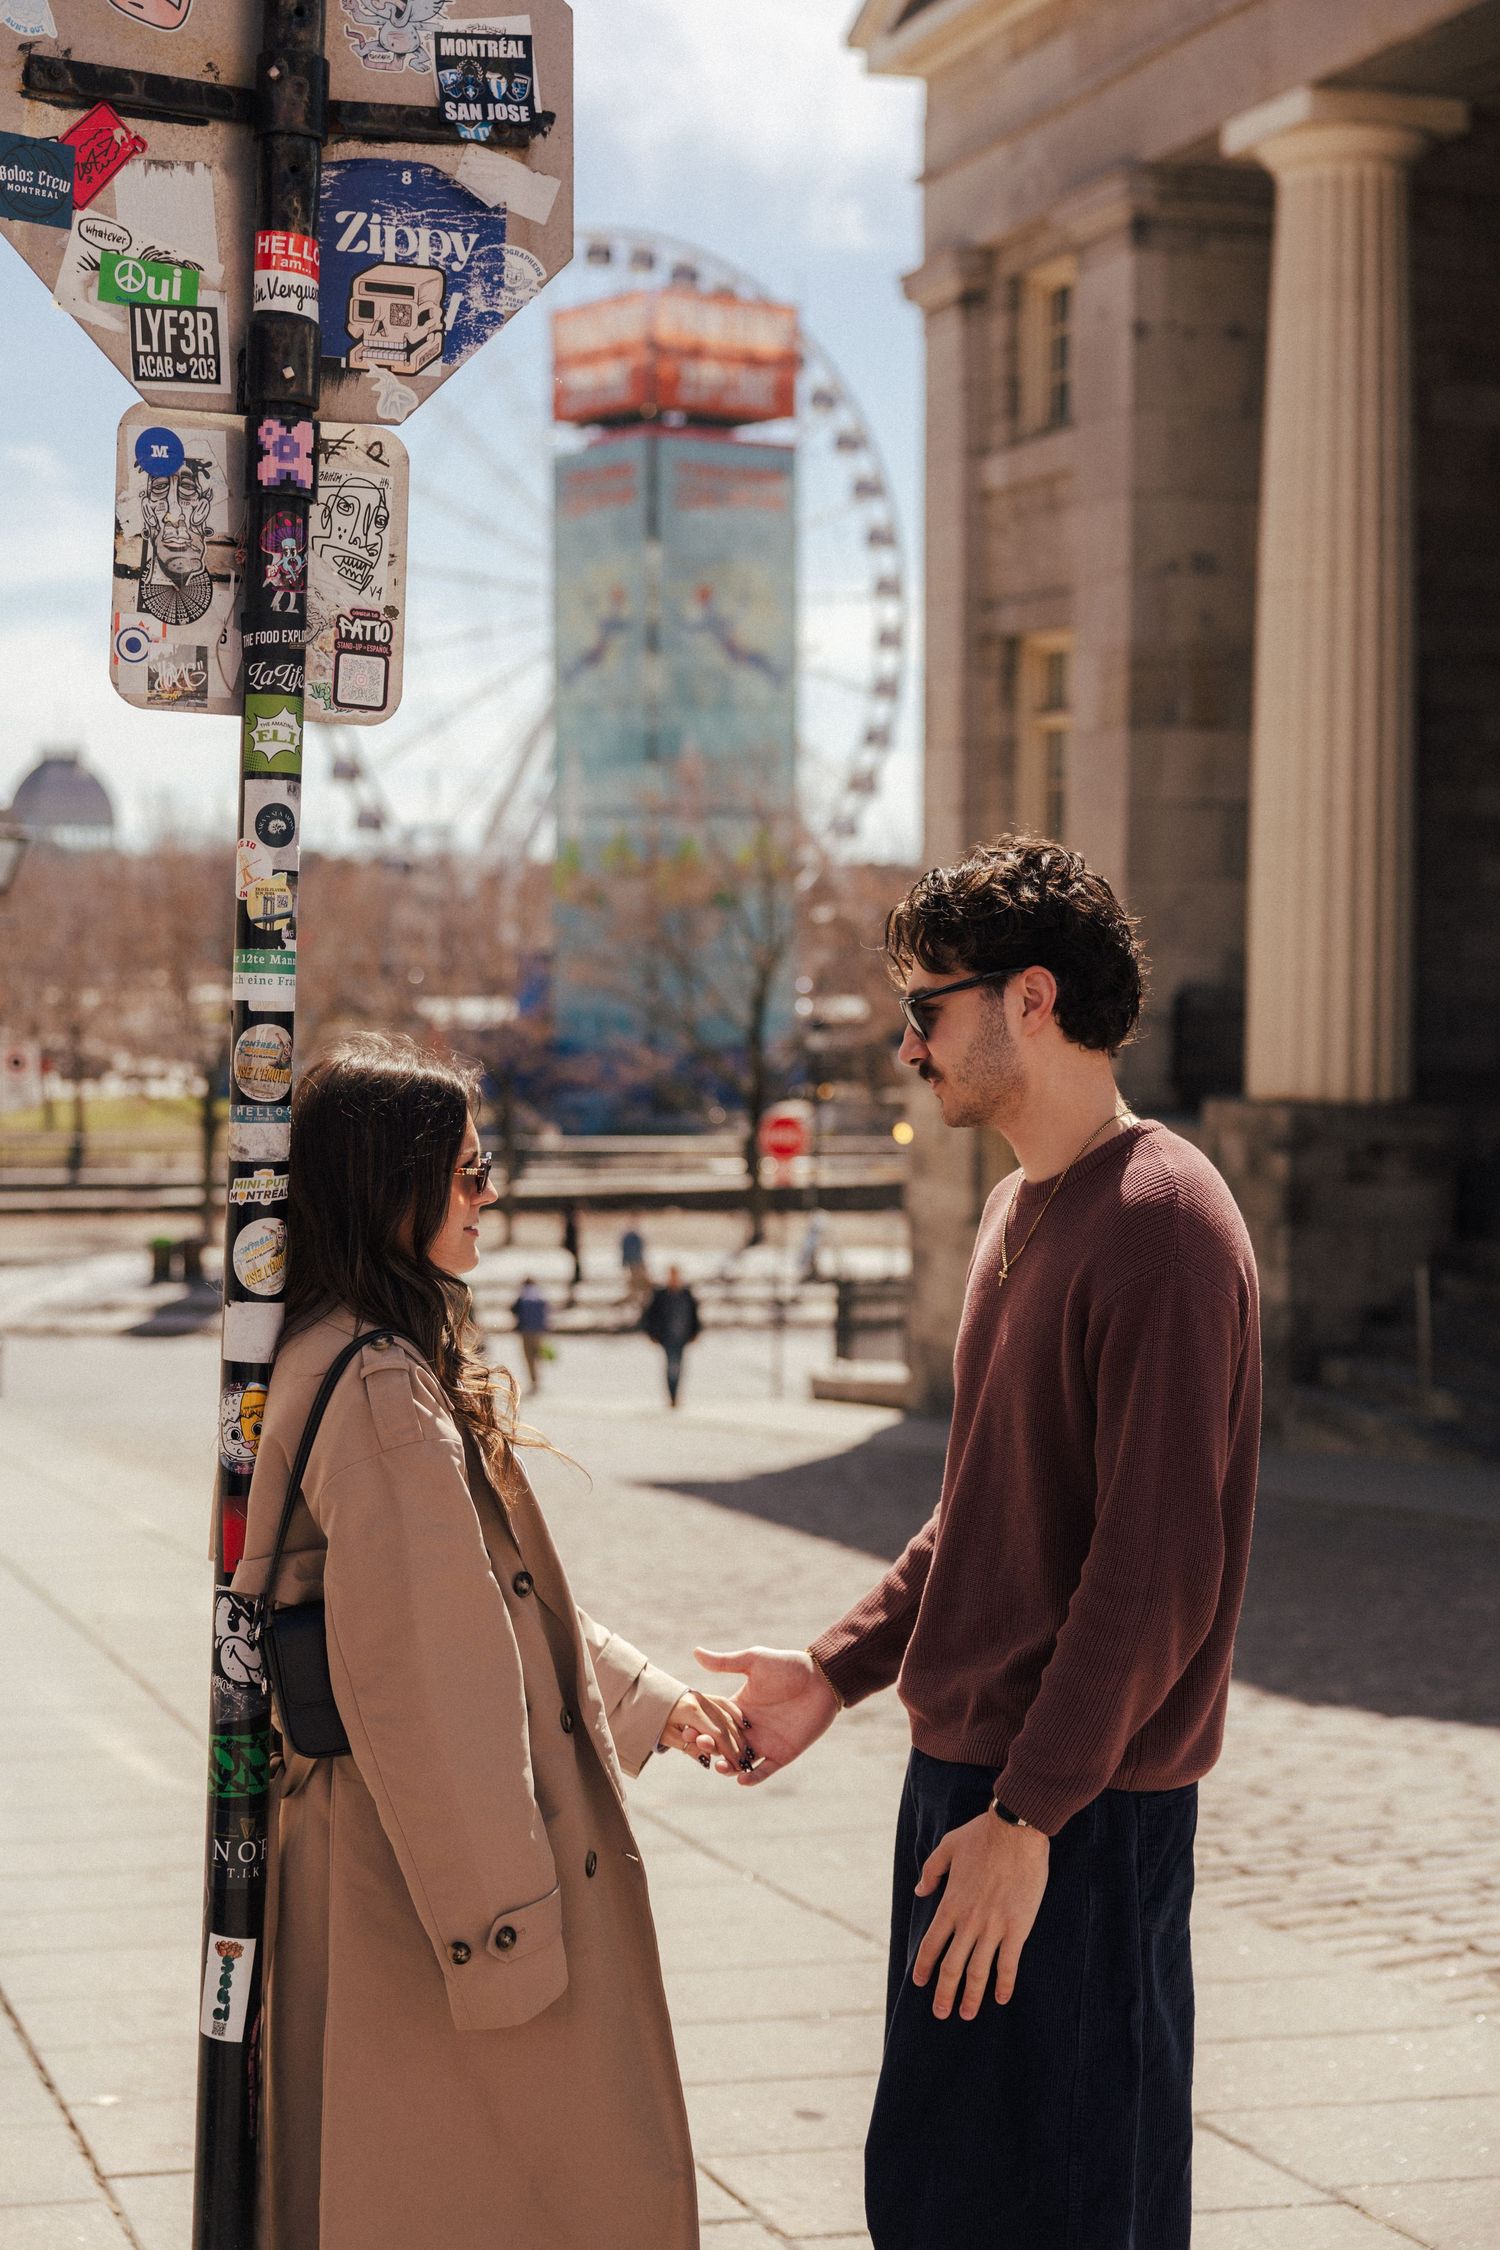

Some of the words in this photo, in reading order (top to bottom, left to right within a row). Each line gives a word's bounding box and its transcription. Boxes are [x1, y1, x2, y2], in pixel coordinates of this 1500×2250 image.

[440, 36, 527, 59] MONTRÉAL
[445, 102, 483, 121] SAN
[487, 103, 531, 123] JOSE
[38, 170, 72, 194] Crew
[401, 170, 412, 185] 8
[7, 183, 59, 200] MONTREAL
[334, 211, 480, 272] Zippy
[134, 306, 216, 356] LYF3R
[138, 355, 175, 378] ACAB
[189, 357, 217, 381] 203
[150, 444, 169, 459] M
[339, 616, 392, 643] PATIO
[243, 633, 254, 648] THE
[255, 630, 280, 645] FOOD
[255, 729, 297, 746] ELI
[241, 954, 265, 964] 12te
[248, 975, 273, 985] eine
[236, 1106, 283, 1117] HELLO
